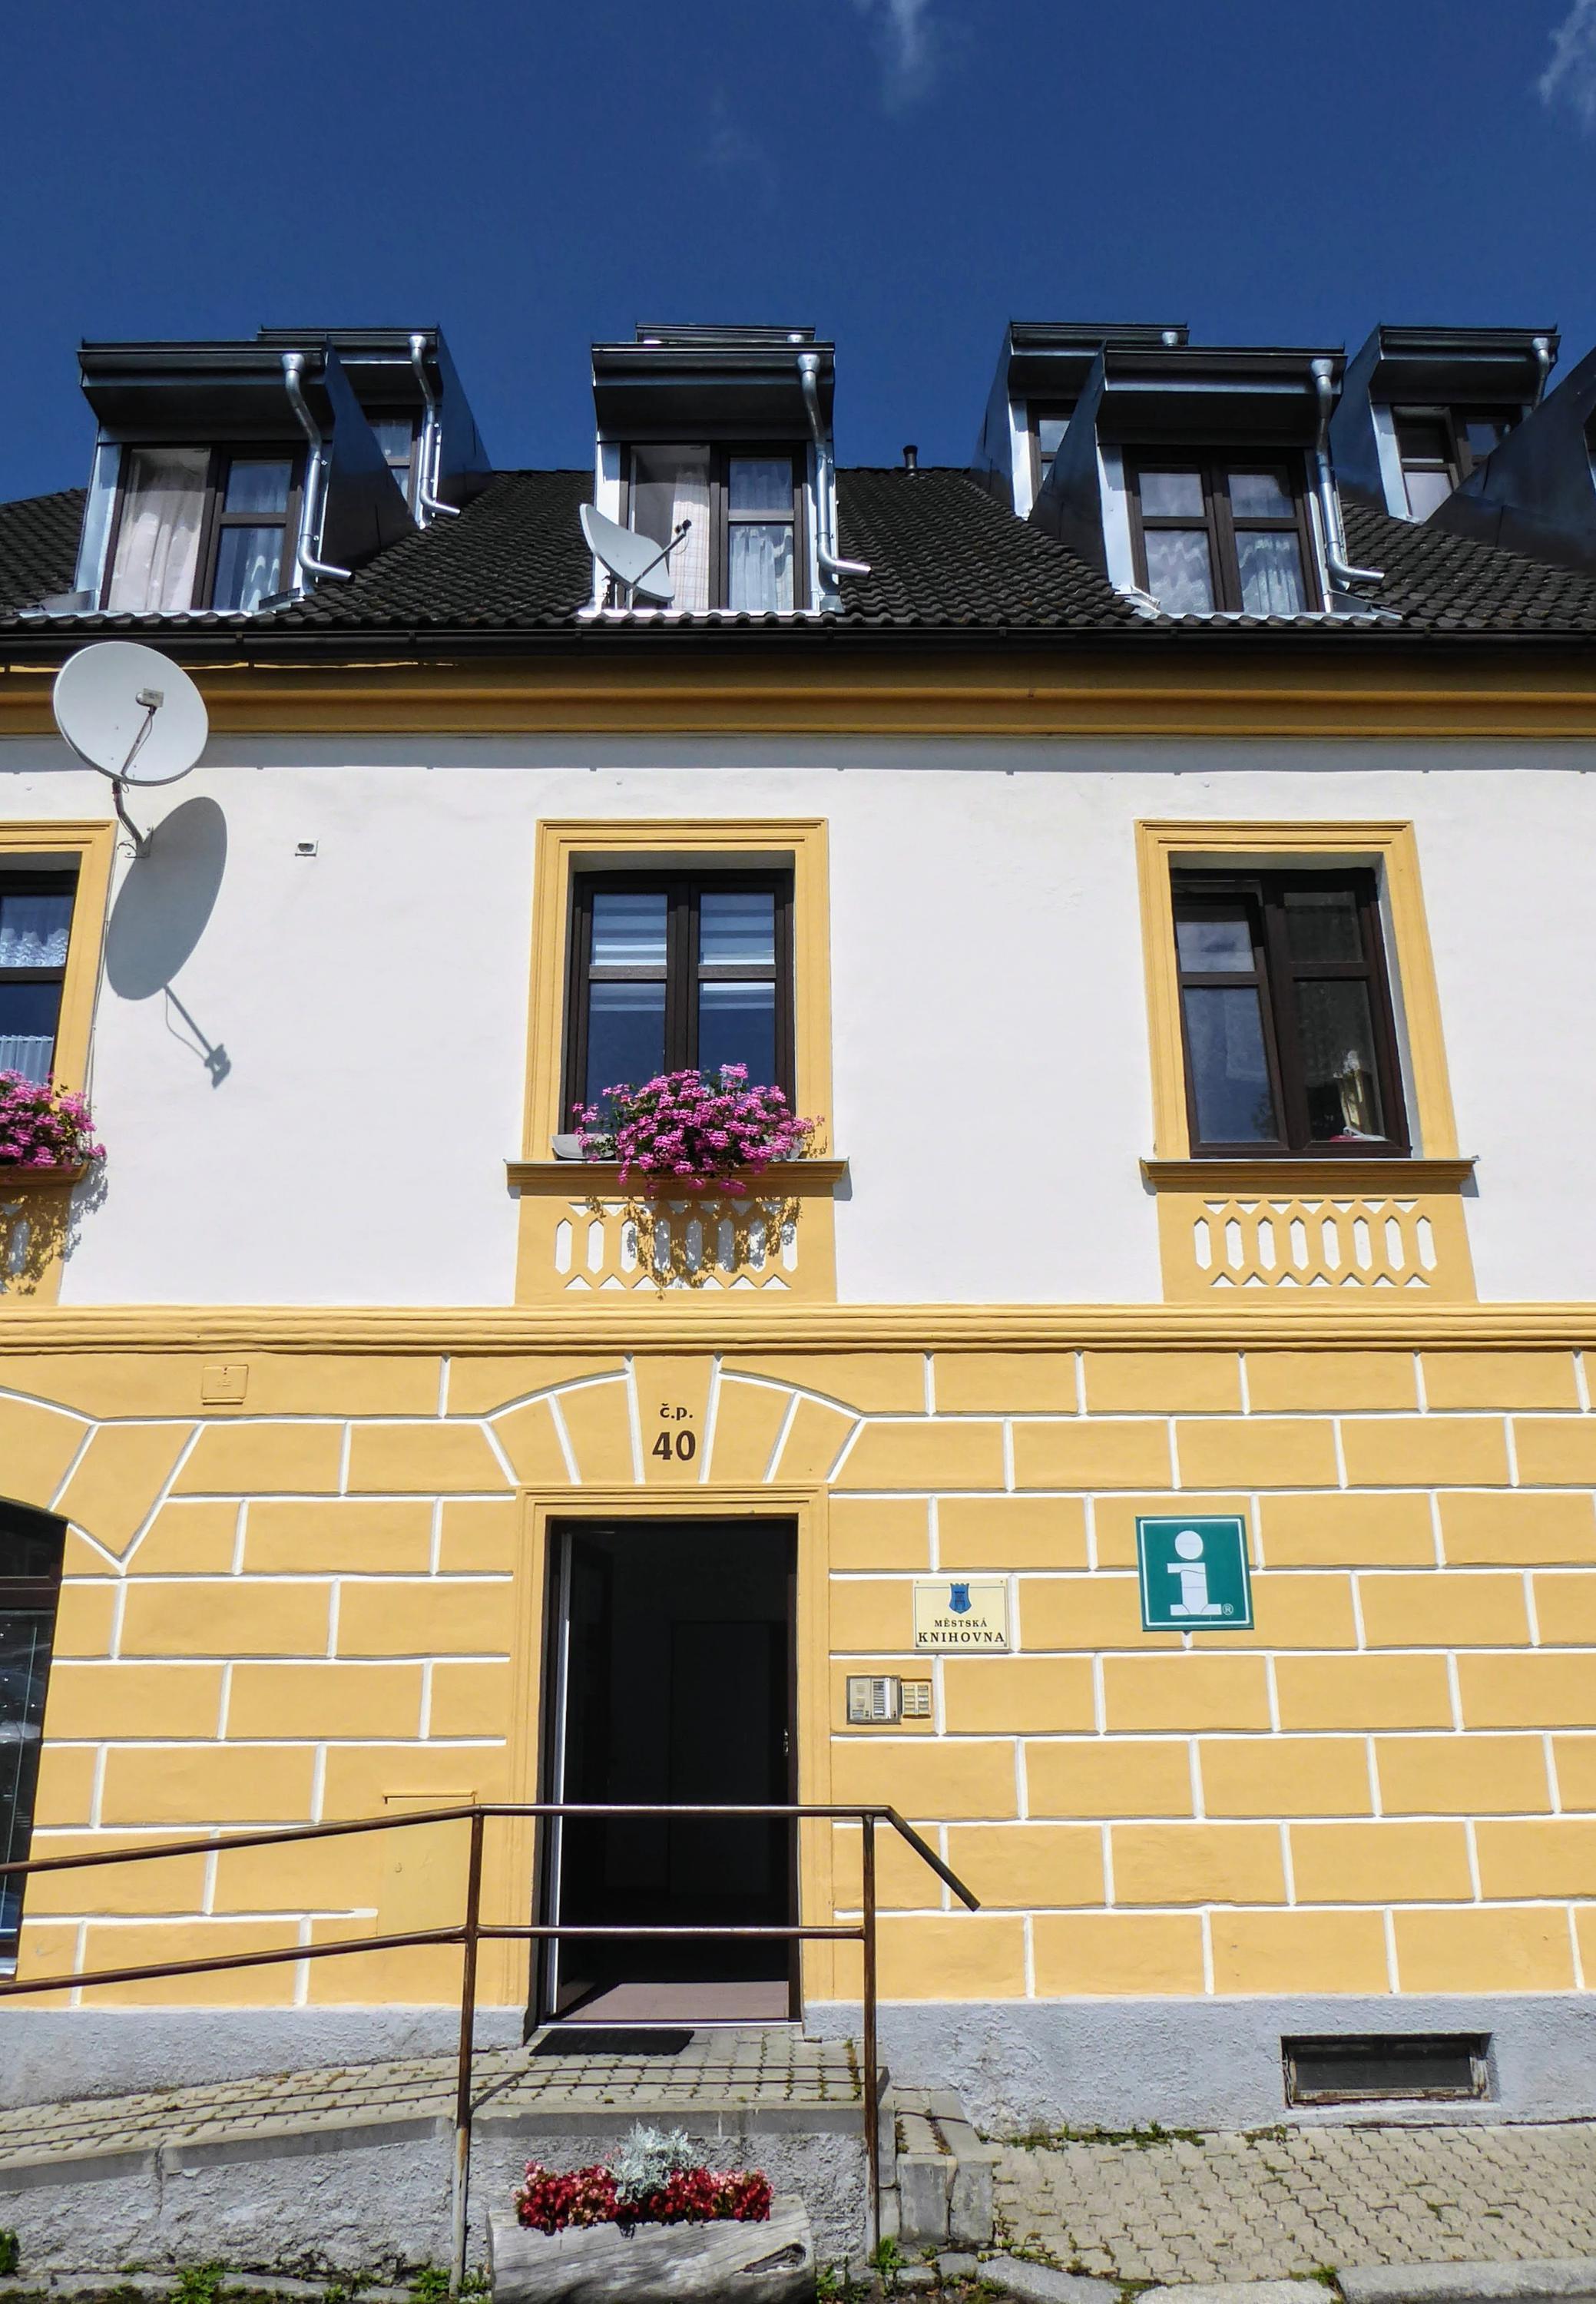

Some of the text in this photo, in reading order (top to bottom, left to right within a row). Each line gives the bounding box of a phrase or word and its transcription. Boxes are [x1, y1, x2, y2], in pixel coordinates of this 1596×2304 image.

[660, 1403, 693, 1421] č.p.
[652, 1430, 696, 1461] 40
[935, 1617, 988, 1627] MĚSTSKÁ
[918, 1632, 1005, 1643] KNIHOVNA
